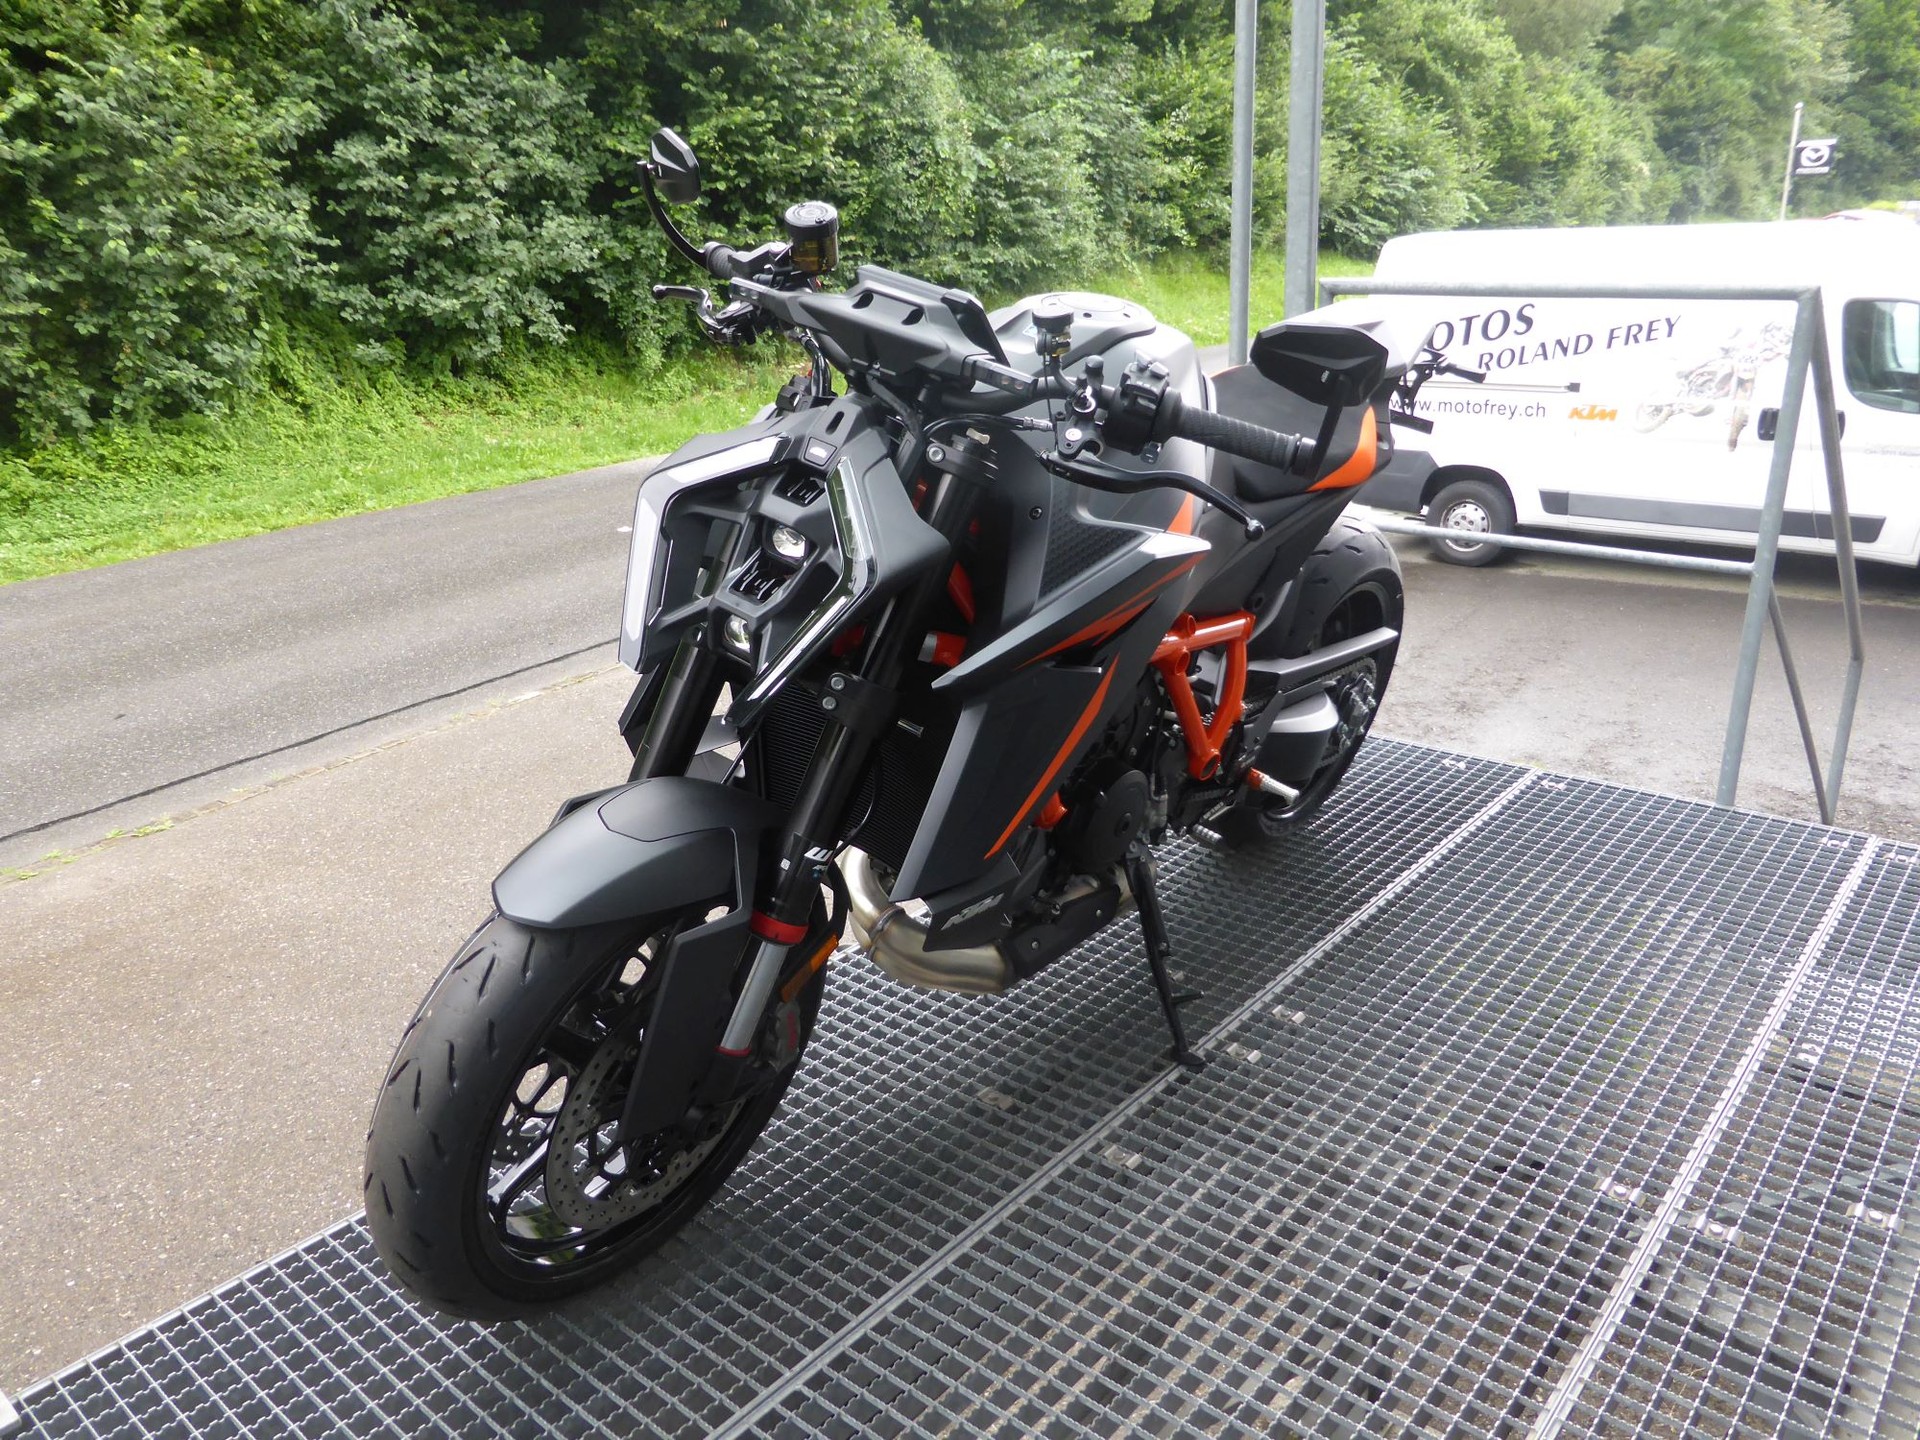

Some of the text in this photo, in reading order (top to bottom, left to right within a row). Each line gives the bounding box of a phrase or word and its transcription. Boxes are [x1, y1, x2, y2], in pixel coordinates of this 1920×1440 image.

[1426, 303, 1536, 351] OTOS
[1478, 315, 1682, 371] ROLAND FREY
[1568, 404, 1618, 421] KTM
